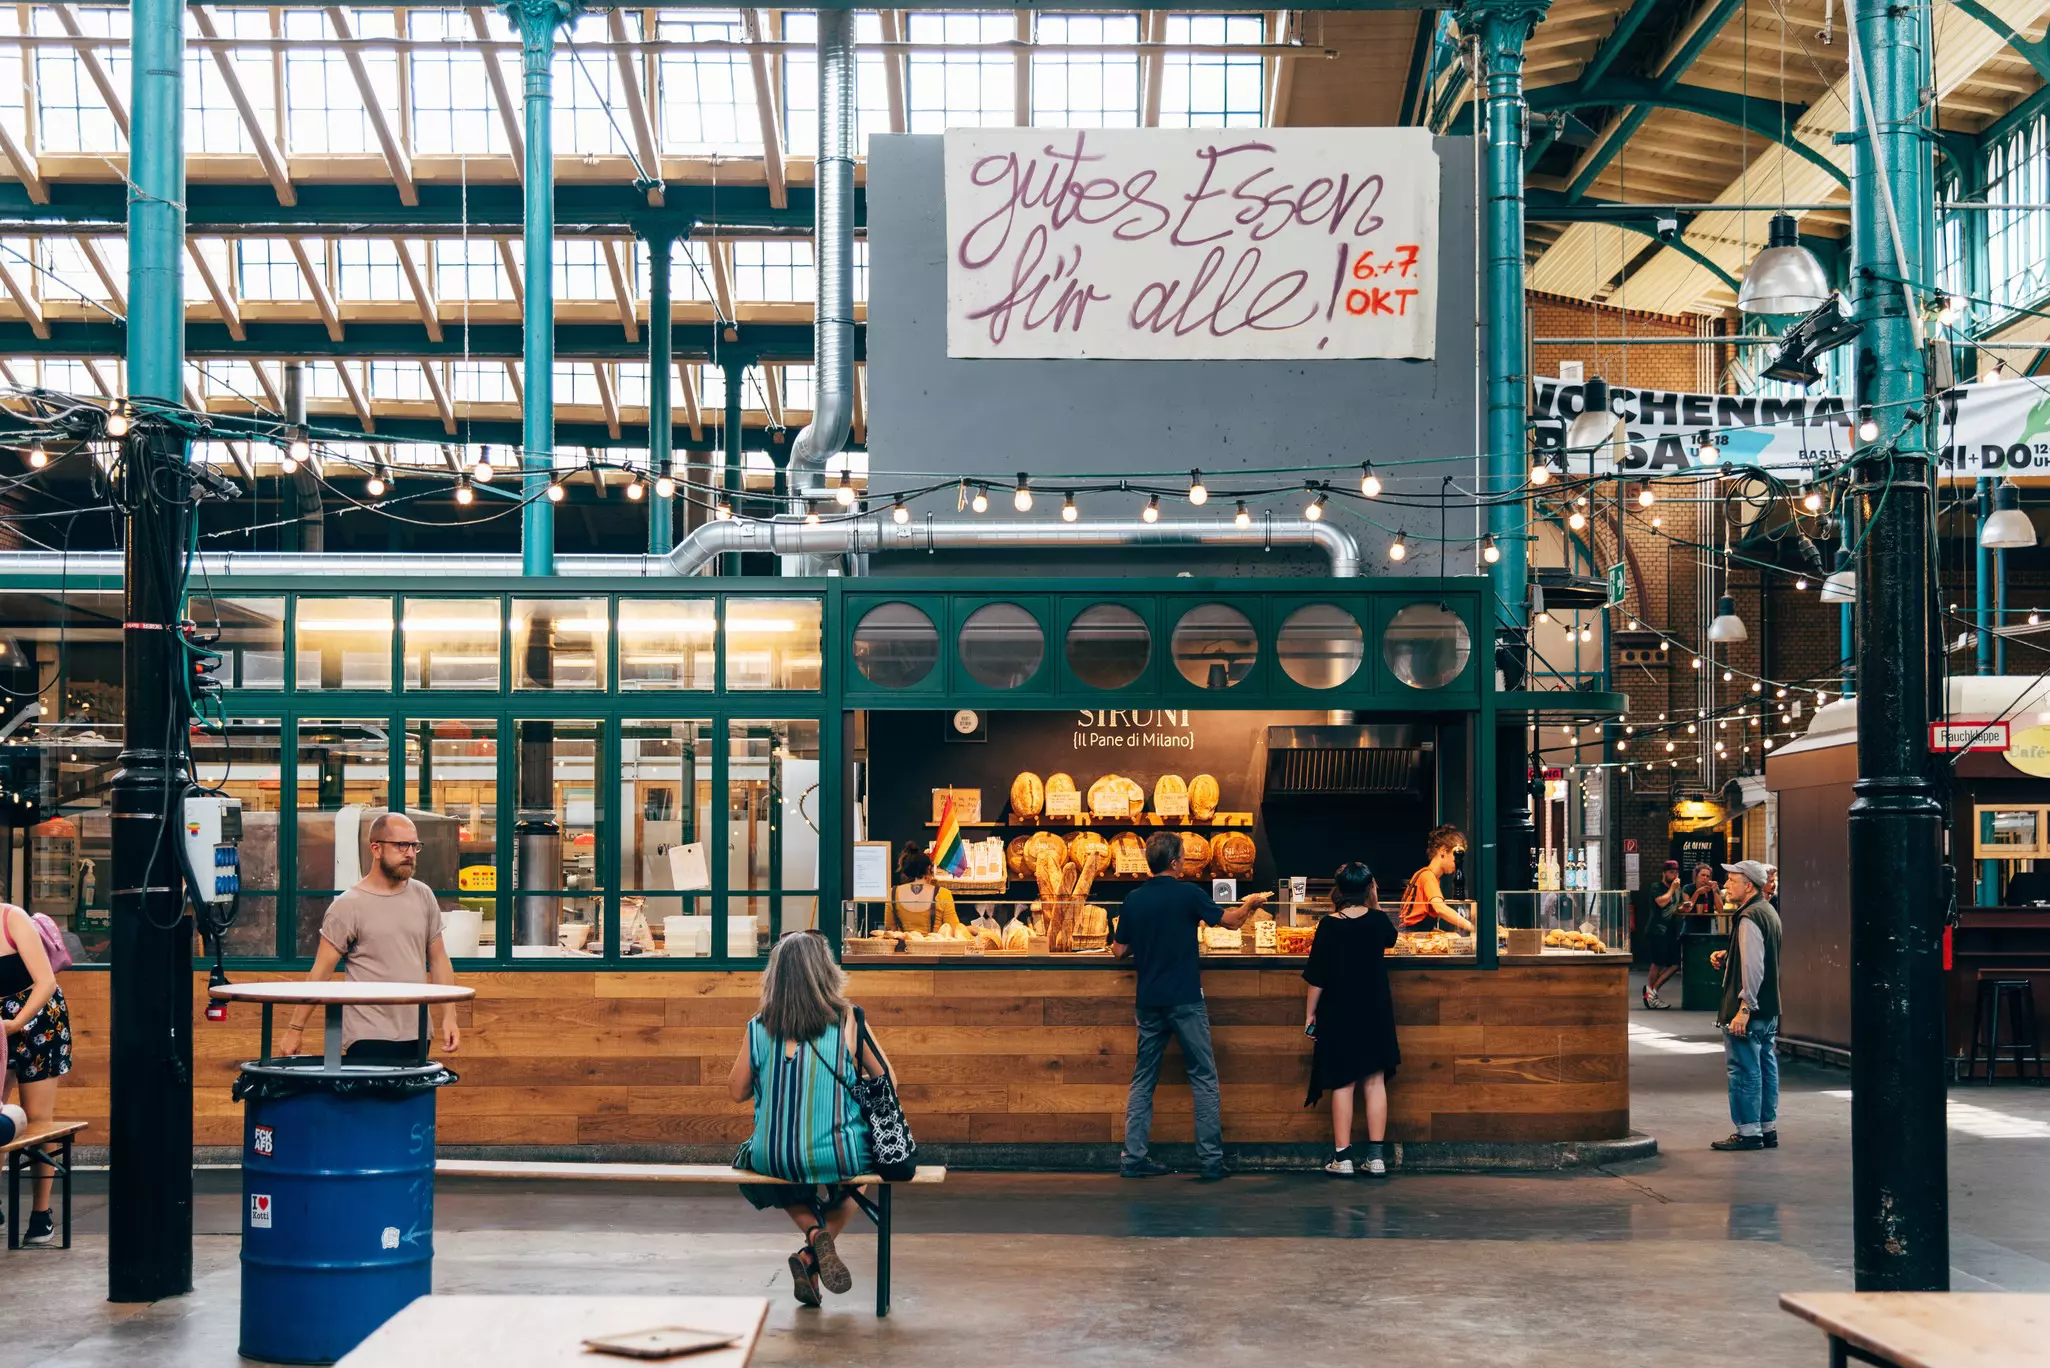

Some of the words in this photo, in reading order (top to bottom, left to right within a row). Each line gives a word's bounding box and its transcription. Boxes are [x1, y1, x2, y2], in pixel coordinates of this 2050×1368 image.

[958, 130, 1170, 270] gutes
[1170, 139, 1385, 247] Essen
[965, 224, 1111, 345] für
[1344, 286, 1420, 317] OKT
[1090, 733, 1124, 746] Pane
[1127, 732, 1139, 746] di
[1941, 730, 2000, 744] Rauchklappe
[254, 1128, 273, 1142] FCK
[254, 1141, 273, 1153] AFD
[252, 1196, 257, 1210] I
[252, 1211, 269, 1220] Kotti
